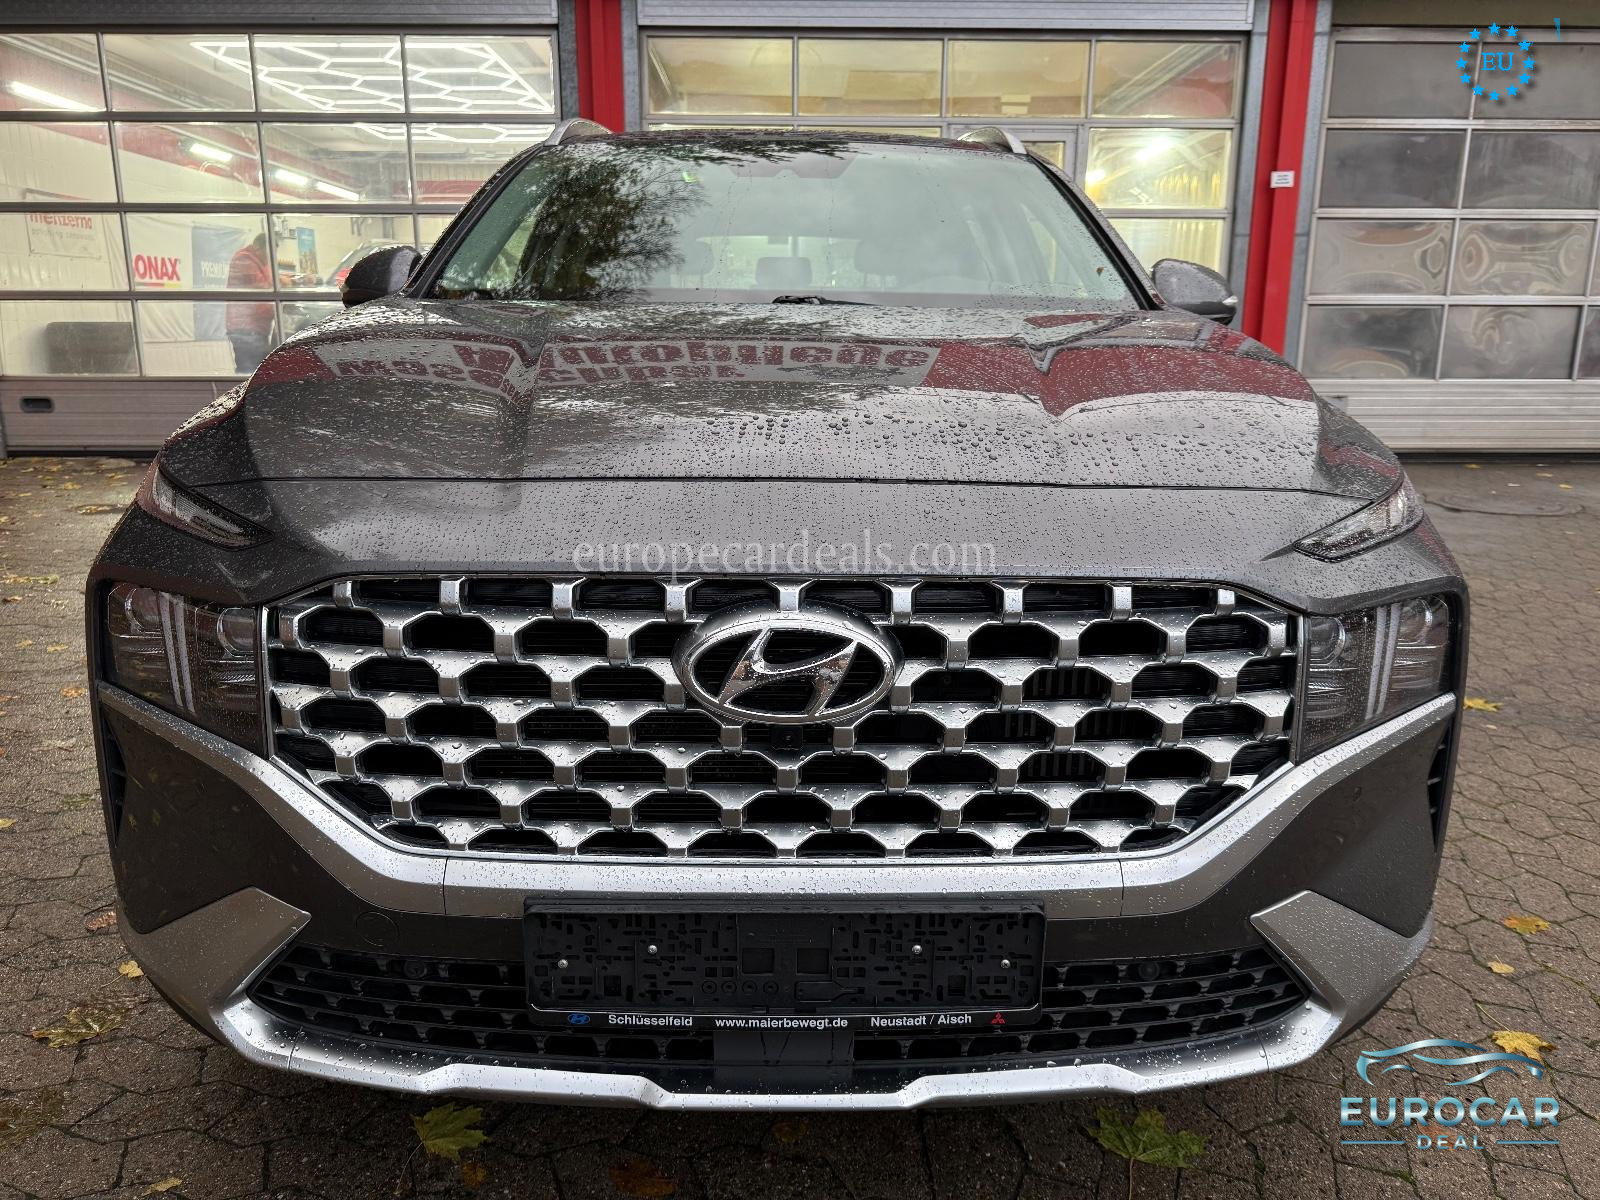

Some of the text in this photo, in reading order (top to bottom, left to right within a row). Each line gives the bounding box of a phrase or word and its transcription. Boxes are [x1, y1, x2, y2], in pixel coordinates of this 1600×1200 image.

[133, 254, 180, 281] ONAX
[608, 1014, 693, 1026] Schlüsselfeld
[715, 1017, 848, 1029] www.maierbewegt.de
[871, 1016, 926, 1027] Neustadt
[937, 1013, 972, 1024] Aisch
